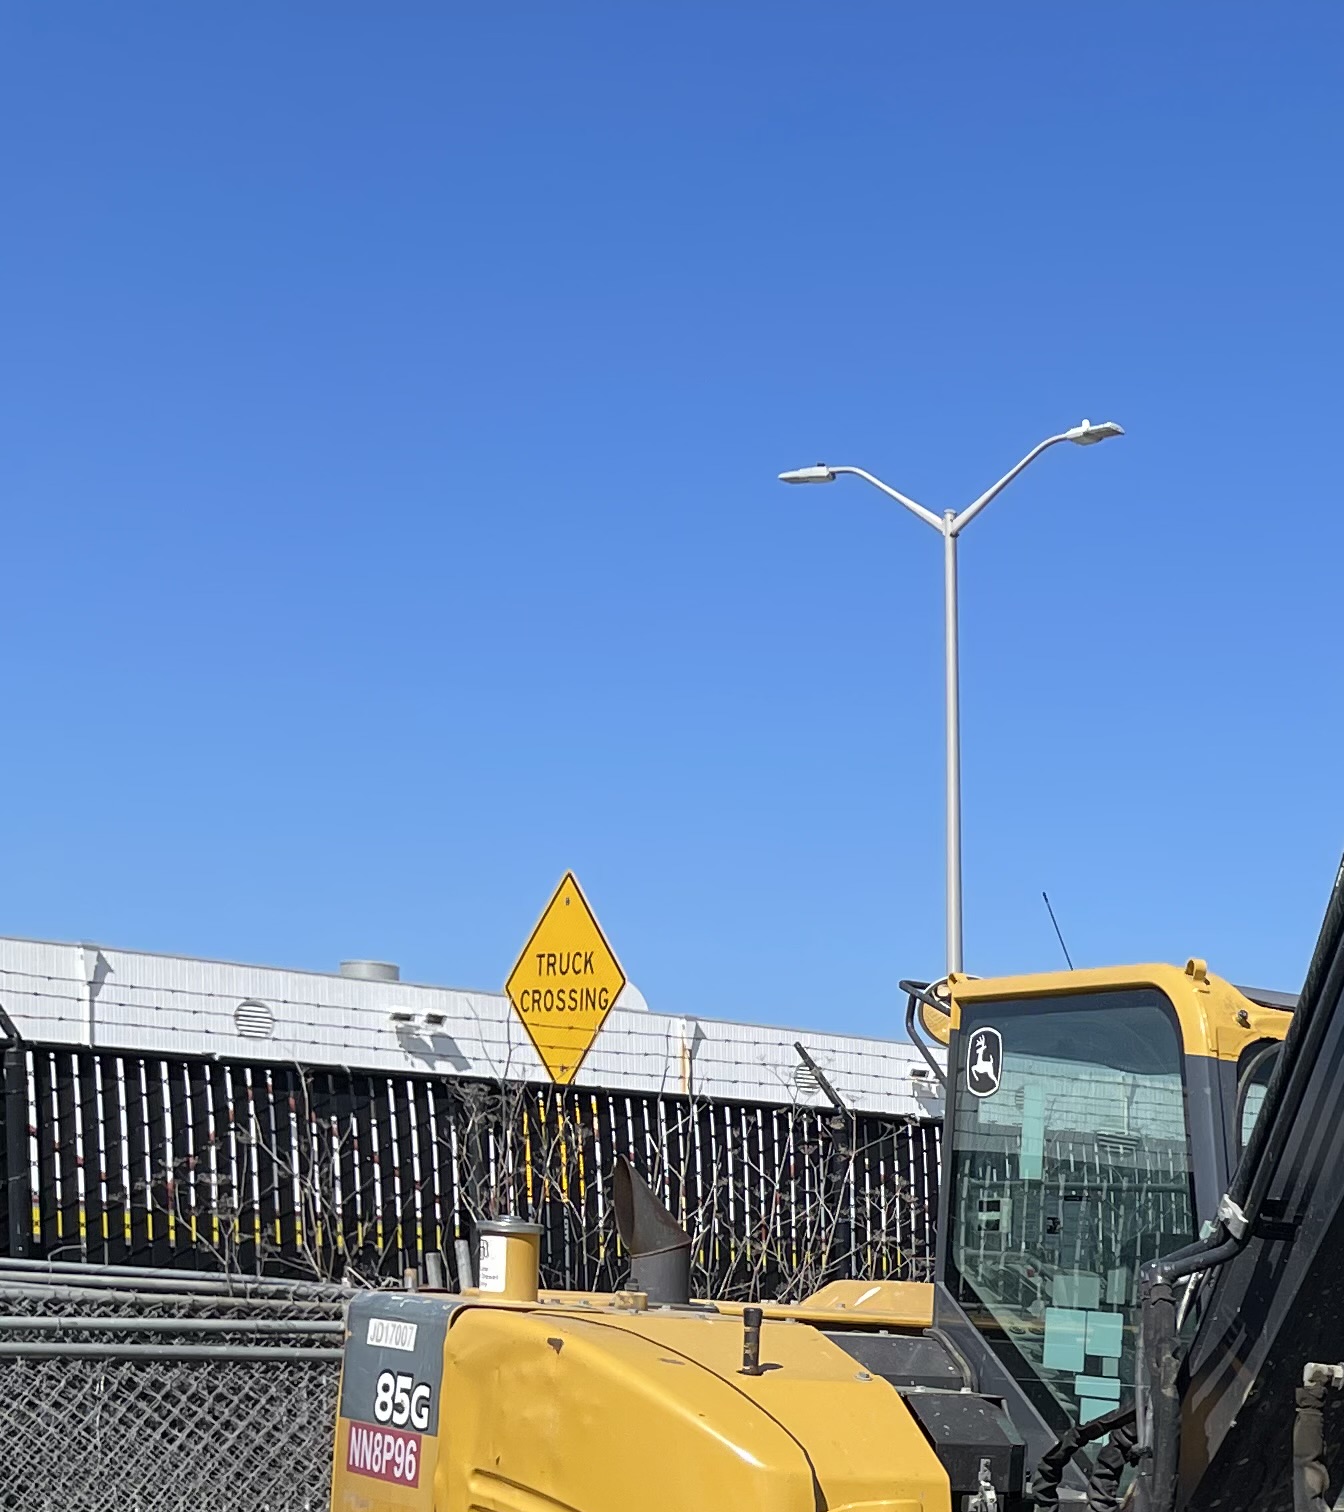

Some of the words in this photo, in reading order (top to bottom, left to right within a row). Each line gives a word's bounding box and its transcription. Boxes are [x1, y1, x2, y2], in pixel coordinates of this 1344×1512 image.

[535, 951, 595, 977] TRUCK
[519, 987, 610, 1013] CROSSING
[369, 1319, 416, 1348] JD17007
[374, 1370, 431, 1431] 85G
[348, 1426, 418, 1482] NN8P96
